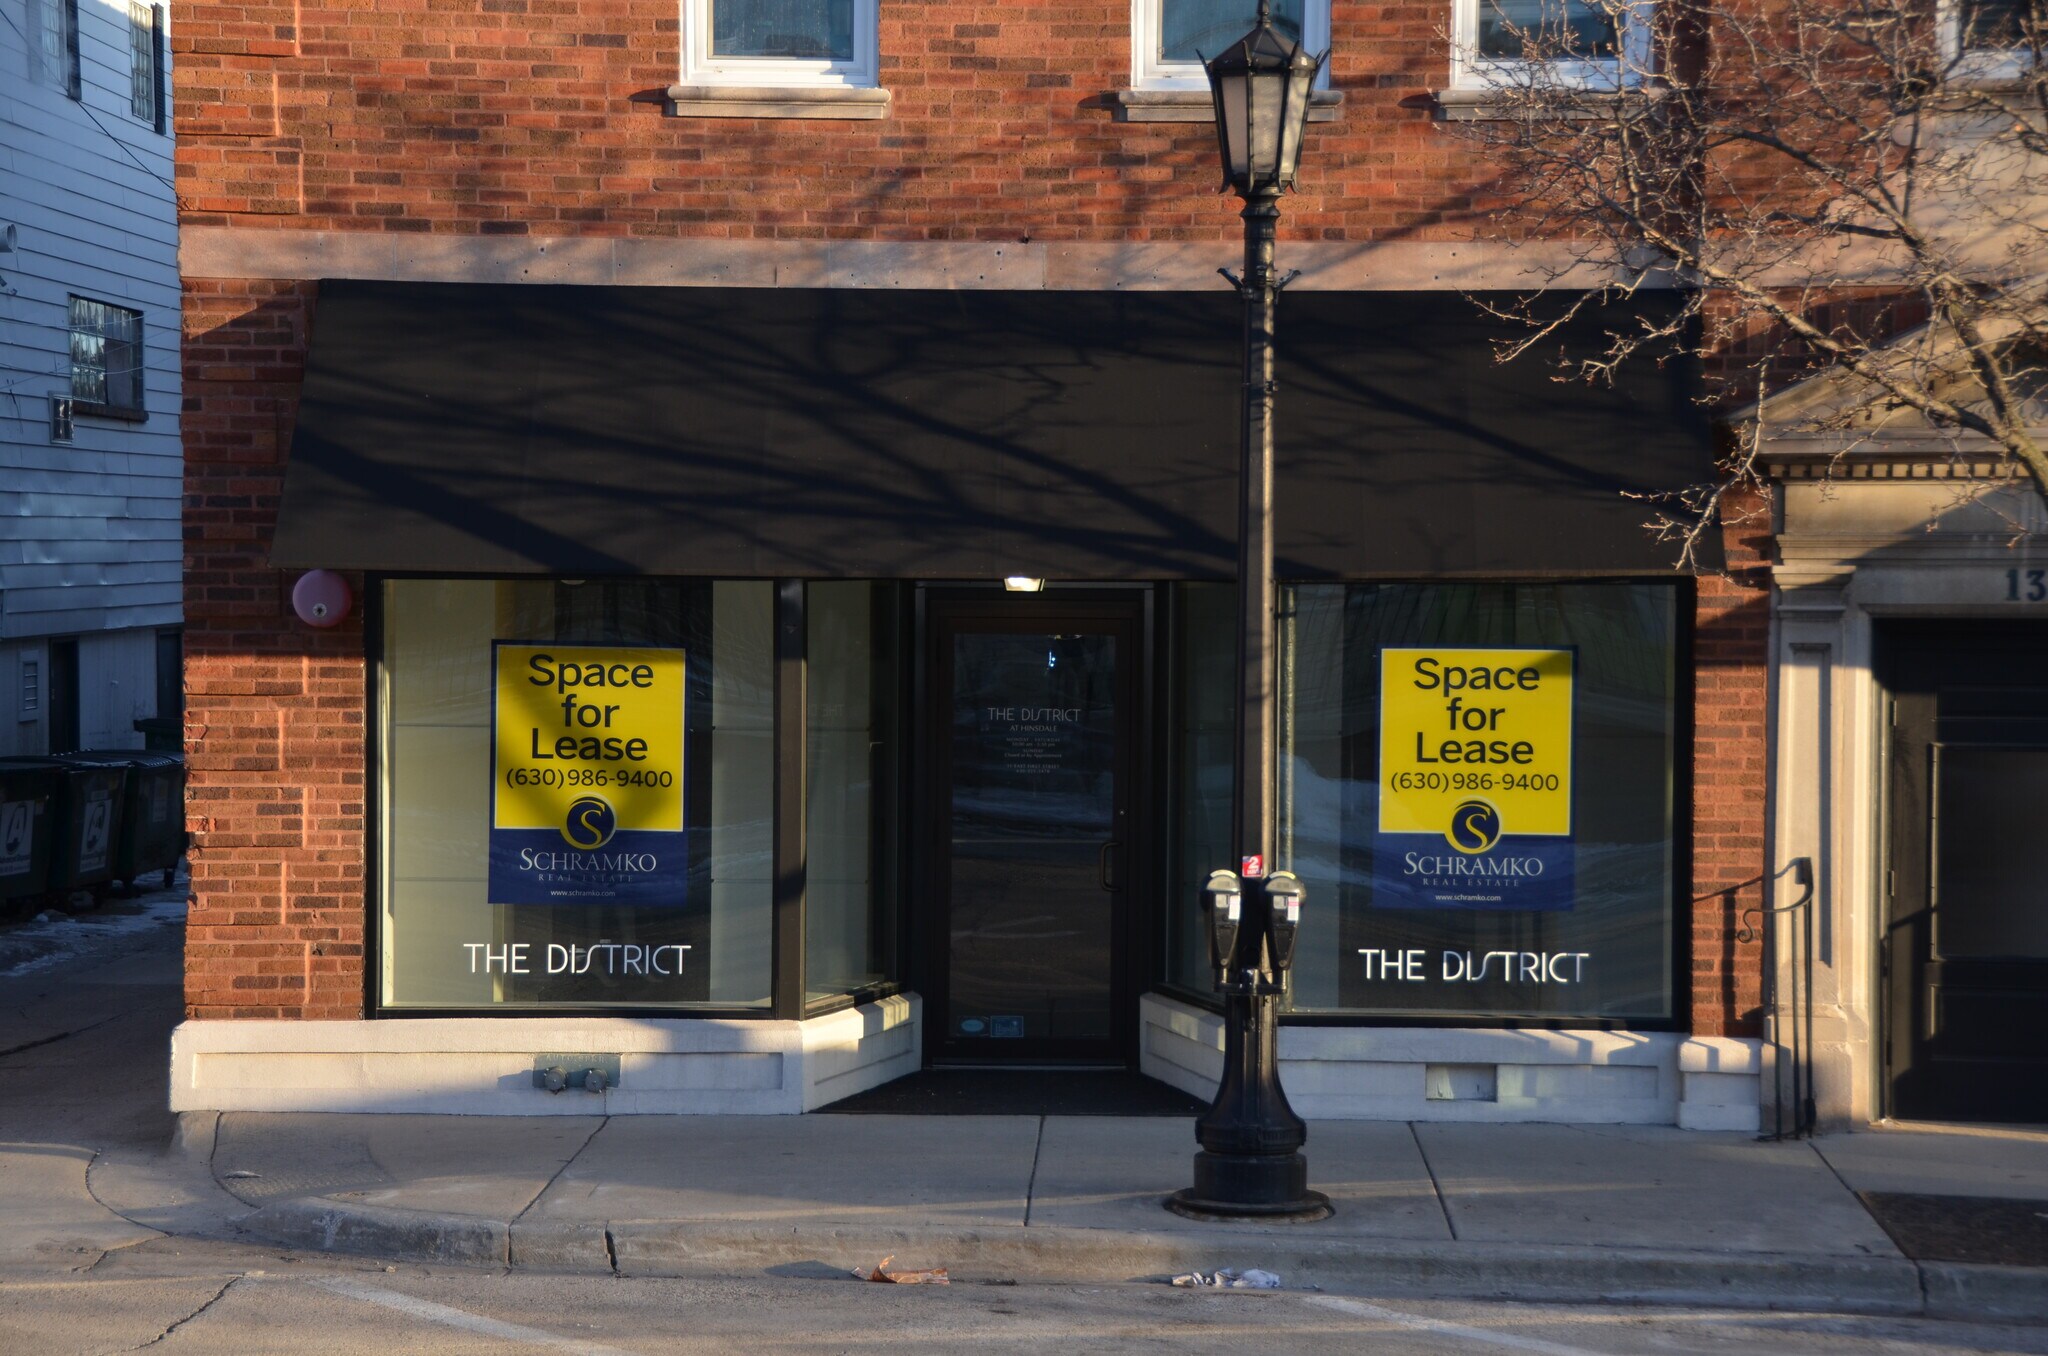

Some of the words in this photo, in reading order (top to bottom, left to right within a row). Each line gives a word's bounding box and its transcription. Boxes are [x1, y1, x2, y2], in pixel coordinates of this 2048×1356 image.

[528, 654, 654, 694] Space
[1413, 657, 1540, 697] Space
[561, 694, 620, 728] for
[987, 707, 1015, 721] THE
[1021, 708, 1081, 722] DISTRICT
[1446, 697, 1505, 731] for
[531, 728, 648, 761] Lease
[1416, 732, 1534, 765] Lease
[506, 768, 673, 789] (630)986-9400
[1390, 772, 1560, 793] (630)986-9400
[519, 847, 657, 872] SCHRAMKO
[1248, 856, 1259, 869] 2
[1404, 851, 1543, 876] SCHRAMKO
[538, 873, 571, 882] REAL
[582, 874, 633, 883] ESTATE
[1423, 878, 1458, 886] REAL
[1467, 879, 1520, 887] ESTATE
[550, 889, 616, 897] www.schramko.com
[1435, 894, 1502, 902] www.schramko.com
[464, 943, 530, 974] THE
[547, 943, 692, 975] DISTRICT
[1358, 948, 1425, 980] THE
[1443, 950, 1589, 983] DISTRICT
